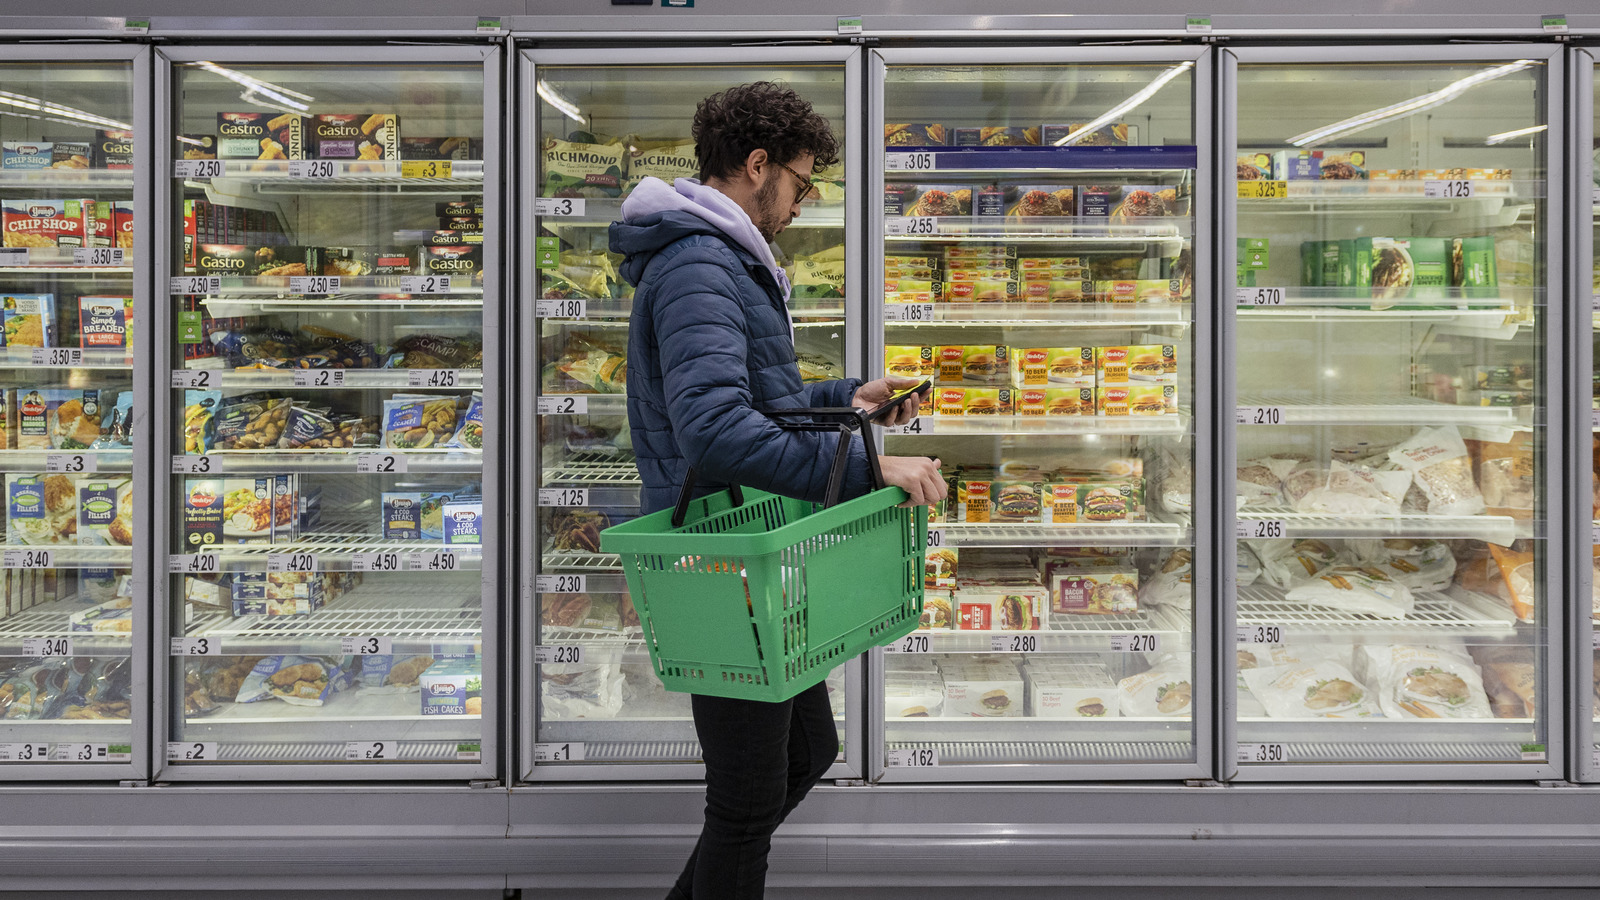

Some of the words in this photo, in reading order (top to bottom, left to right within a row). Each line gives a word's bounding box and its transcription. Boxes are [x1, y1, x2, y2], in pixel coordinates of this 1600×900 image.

[220, 123, 263, 135] Gastro
[317, 125, 359, 136] Gastro
[291, 118, 299, 160] CHUNK
[386, 119, 394, 160] CHUNK
[5, 157, 26, 165] CHIP
[26, 156, 50, 165] SHOP
[547, 151, 617, 165] RICHMOND
[905, 154, 931, 169] £3.05
[194, 161, 220, 177] £2.50
[307, 161, 333, 177] £2.50
[423, 162, 437, 177] £3
[1444, 181, 1470, 197] £1.25
[445, 207, 472, 215] Gastro
[554, 199, 573, 215] £3
[8, 219, 41, 232] CHIP
[42, 219, 78, 232] SHOP
[907, 218, 933, 233] £2.55
[432, 235, 459, 244] Gastro
[91, 249, 111, 265] £3.50
[201, 256, 245, 269] Gastro
[429, 259, 474, 270] Gastro
[188, 278, 208, 293] £2.50
[308, 278, 328, 293] £2.50
[421, 277, 435, 292] £2
[1254, 289, 1280, 304] £5.70
[555, 301, 581, 317] £1.80
[902, 305, 922, 320] £1.85
[84, 325, 125, 334] BREADED
[91, 317, 117, 326] Simply
[49, 350, 70, 365] £3.50
[191, 371, 209, 387] £2
[314, 371, 329, 386] £2
[428, 370, 454, 386] £4.25
[557, 397, 575, 414] £2
[1254, 408, 1280, 424] £2.10
[903, 418, 922, 434] £4
[65, 455, 84, 471] £3
[191, 456, 210, 473] £3
[376, 456, 395, 472] £2
[557, 490, 584, 506] £1.25
[453, 527, 477, 536] STEAKS
[1255, 521, 1281, 537] £2.65
[23, 551, 49, 568] £3.40
[188, 555, 214, 571] £4.20
[287, 555, 313, 571] £4.20
[371, 554, 397, 570] £4.50
[429, 554, 455, 570] £4.50
[555, 576, 581, 592] £2.30
[1130, 635, 1155, 651] £2.70
[1254, 627, 1280, 643] £3.50
[42, 639, 68, 656] £3.40
[190, 638, 209, 655] £3
[361, 637, 379, 654] £3
[902, 636, 928, 653] £2.70
[1010, 636, 1036, 652] £2.80
[554, 646, 580, 663] £2.30
[424, 706, 439, 714] FISH
[441, 705, 464, 714] CAKES
[18, 744, 33, 760] £3
[78, 744, 92, 760] £3
[186, 743, 205, 760] £2
[366, 742, 384, 759] £2
[553, 743, 570, 760] £1
[907, 750, 933, 766] £1.62
[1256, 744, 1282, 761] £3.50
